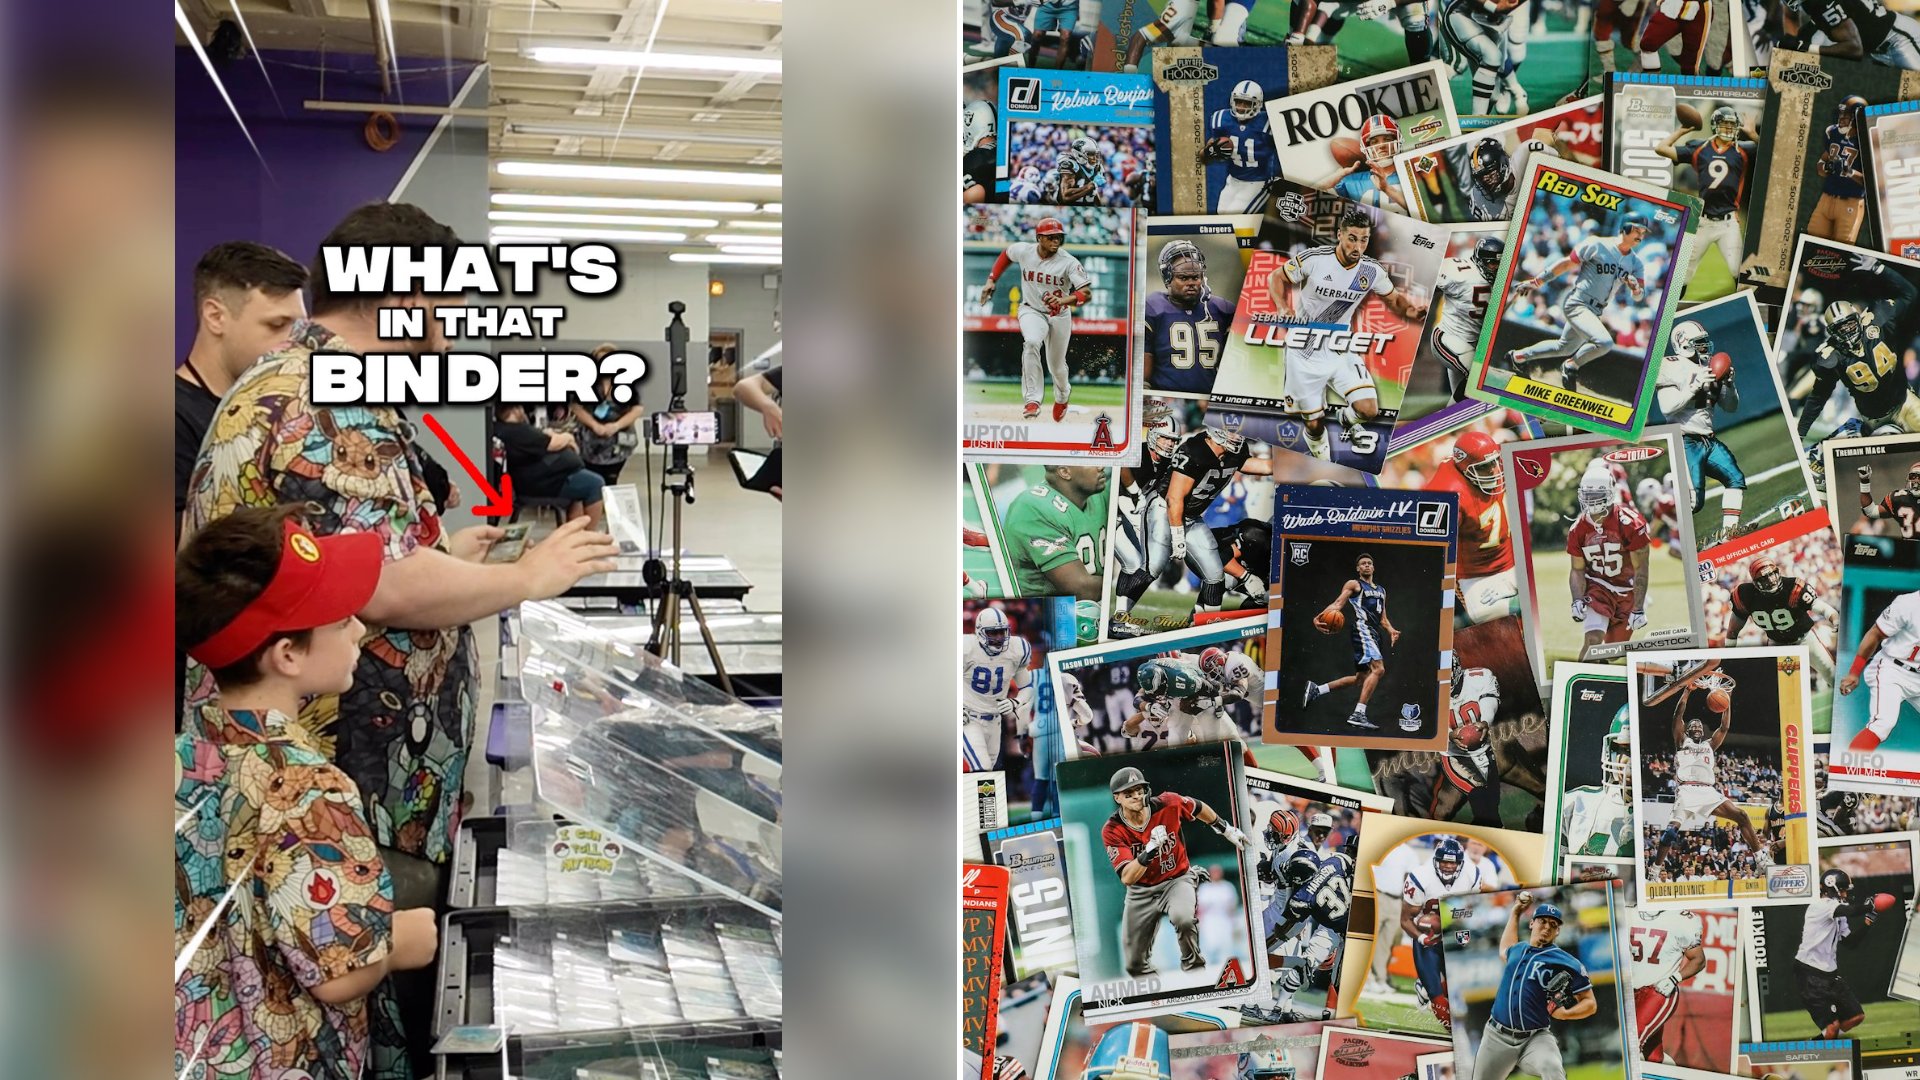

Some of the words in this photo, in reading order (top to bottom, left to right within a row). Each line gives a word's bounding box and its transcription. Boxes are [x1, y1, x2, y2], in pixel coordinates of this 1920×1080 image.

[1165, 67, 1216, 81] HONORS
[1781, 70, 1829, 88] HONORS
[1051, 88, 1101, 111] Kelvin
[1693, 89, 1759, 99] QUARTERBACK
[1279, 75, 1440, 147] ROOKIE
[1708, 159, 1729, 190] 9
[1199, 226, 1233, 235] Chargers
[1251, 311, 1309, 326] SEBASTIAN
[1170, 320, 1220, 370] 95
[1243, 323, 1395, 354] LLETGET
[1845, 340, 1899, 394] 94
[1225, 396, 1254, 405] UNDER
[1523, 382, 1552, 404] MIKE
[1553, 392, 1615, 419] GREENWELL
[1226, 416, 1240, 426] LA
[963, 424, 1029, 441] UPTON
[1281, 429, 1296, 438] LA
[969, 440, 1005, 449] JUSTIN
[1340, 430, 1379, 455] #3
[1627, 449, 1649, 461] TOTAL
[1835, 449, 1864, 458] TREMAIN
[1865, 446, 1886, 455] MACK
[1282, 510, 1323, 530] Wade
[1327, 505, 1385, 525] Baldwin
[1388, 500, 1414, 518] IV
[1382, 524, 1412, 535] GRIZZLIES
[1293, 548, 1307, 560] RC
[1715, 555, 1726, 564] THE
[1726, 547, 1750, 561] OFFICIAL
[1750, 543, 1760, 553] NFL
[1760, 537, 1775, 548] CARD
[1581, 542, 1623, 579] 55
[1751, 607, 1795, 631] 99
[1112, 626, 1139, 635] Oakland
[1241, 626, 1265, 638] Eagles
[1650, 629, 1671, 637] ROOKIE
[1590, 645, 1622, 656] Darryl
[1624, 636, 1691, 652] BLACKSTOCK
[1062, 658, 1083, 670] JASON
[1083, 655, 1105, 667] DUNN
[971, 666, 1004, 695] 81
[1840, 751, 1885, 769] DIFO
[1784, 724, 1803, 814] CLIPPERS
[1845, 765, 1887, 777] WILMER
[1331, 796, 1360, 809] Bengals
[1010, 853, 1055, 869] Bowman
[1650, 885, 1672, 900] OLDEN
[1674, 884, 1706, 899] POLYNICE
[1769, 876, 1806, 893] CLIPPERS
[1629, 926, 1668, 965] 57
[1752, 909, 1768, 968] ROOKIE
[1091, 977, 1162, 1001] AHMED
[1097, 997, 1124, 1009] NICK
[1166, 995, 1196, 1004] ARIZONA
[1785, 1053, 1820, 1061] SAFETY
